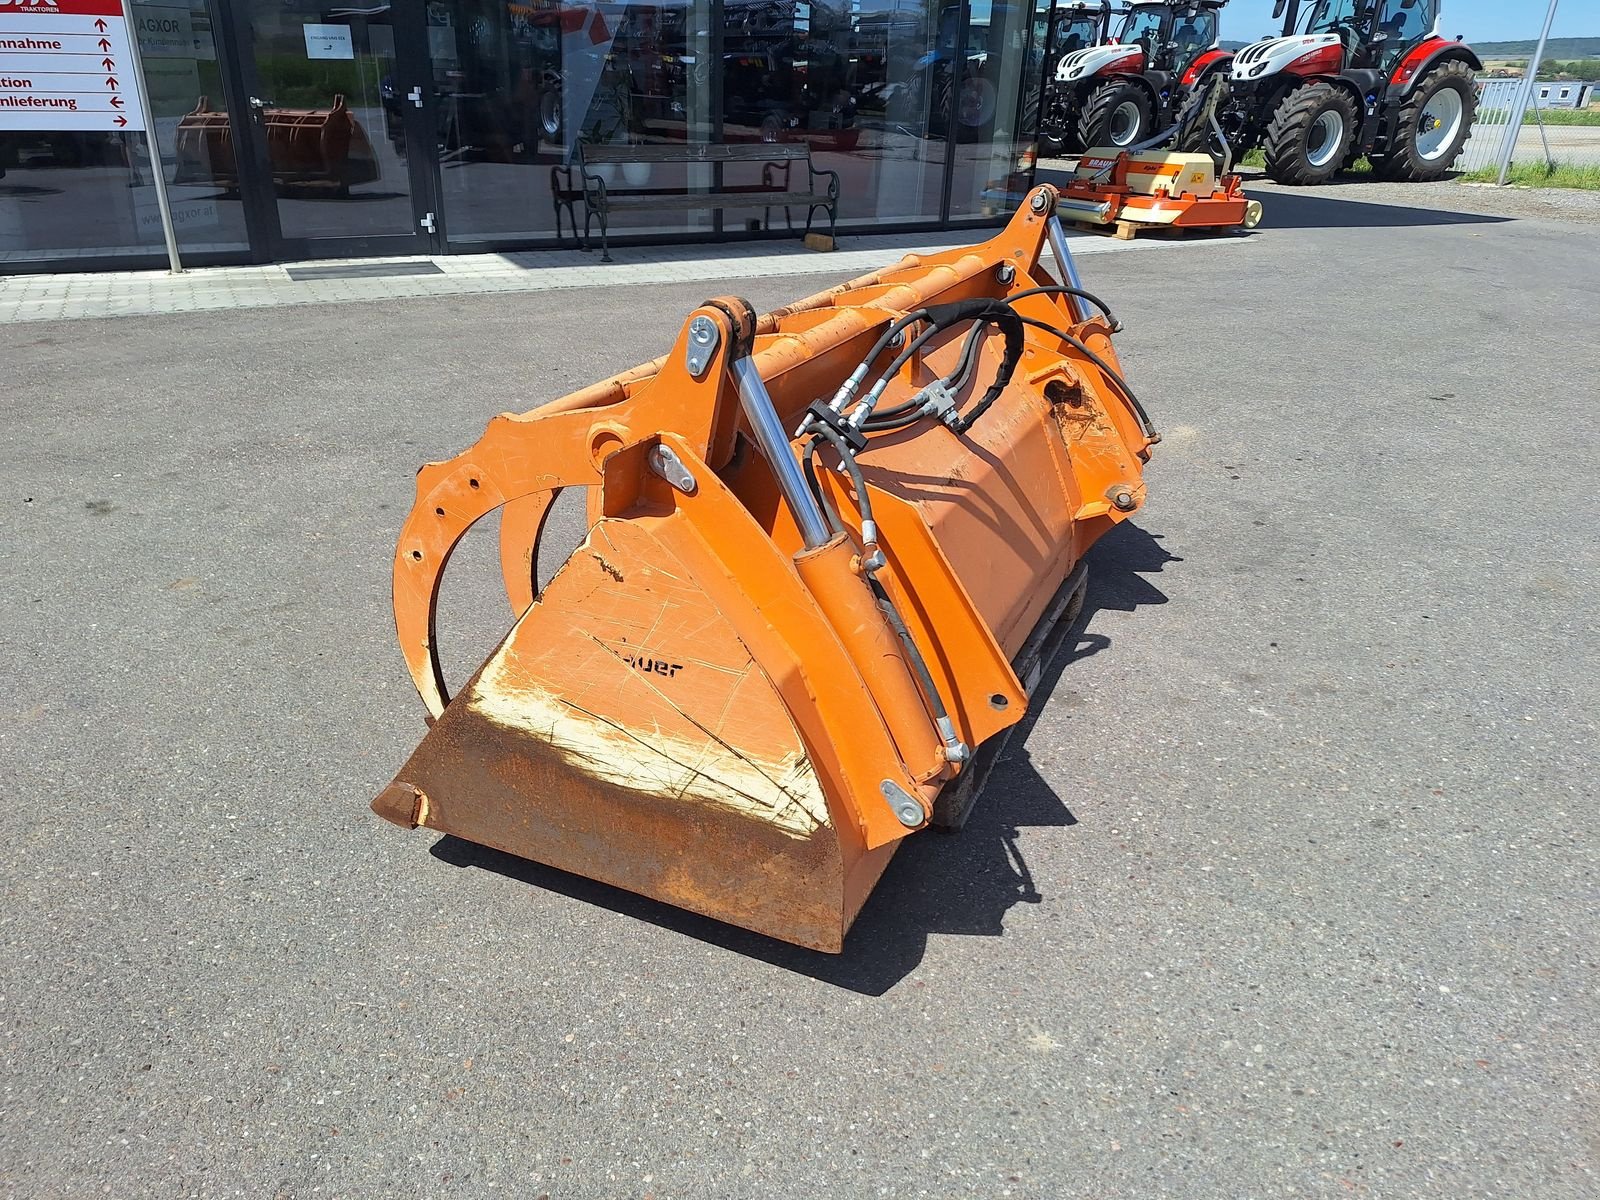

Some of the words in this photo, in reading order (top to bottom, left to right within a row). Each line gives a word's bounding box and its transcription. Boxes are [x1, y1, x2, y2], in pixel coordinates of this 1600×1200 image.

[140, 18, 180, 33] AGXOR
[0, 38, 62, 50] nnahme
[0, 77, 32, 88] tion
[0, 96, 77, 111] nlieferung
[141, 205, 214, 226] wwagxor.at
